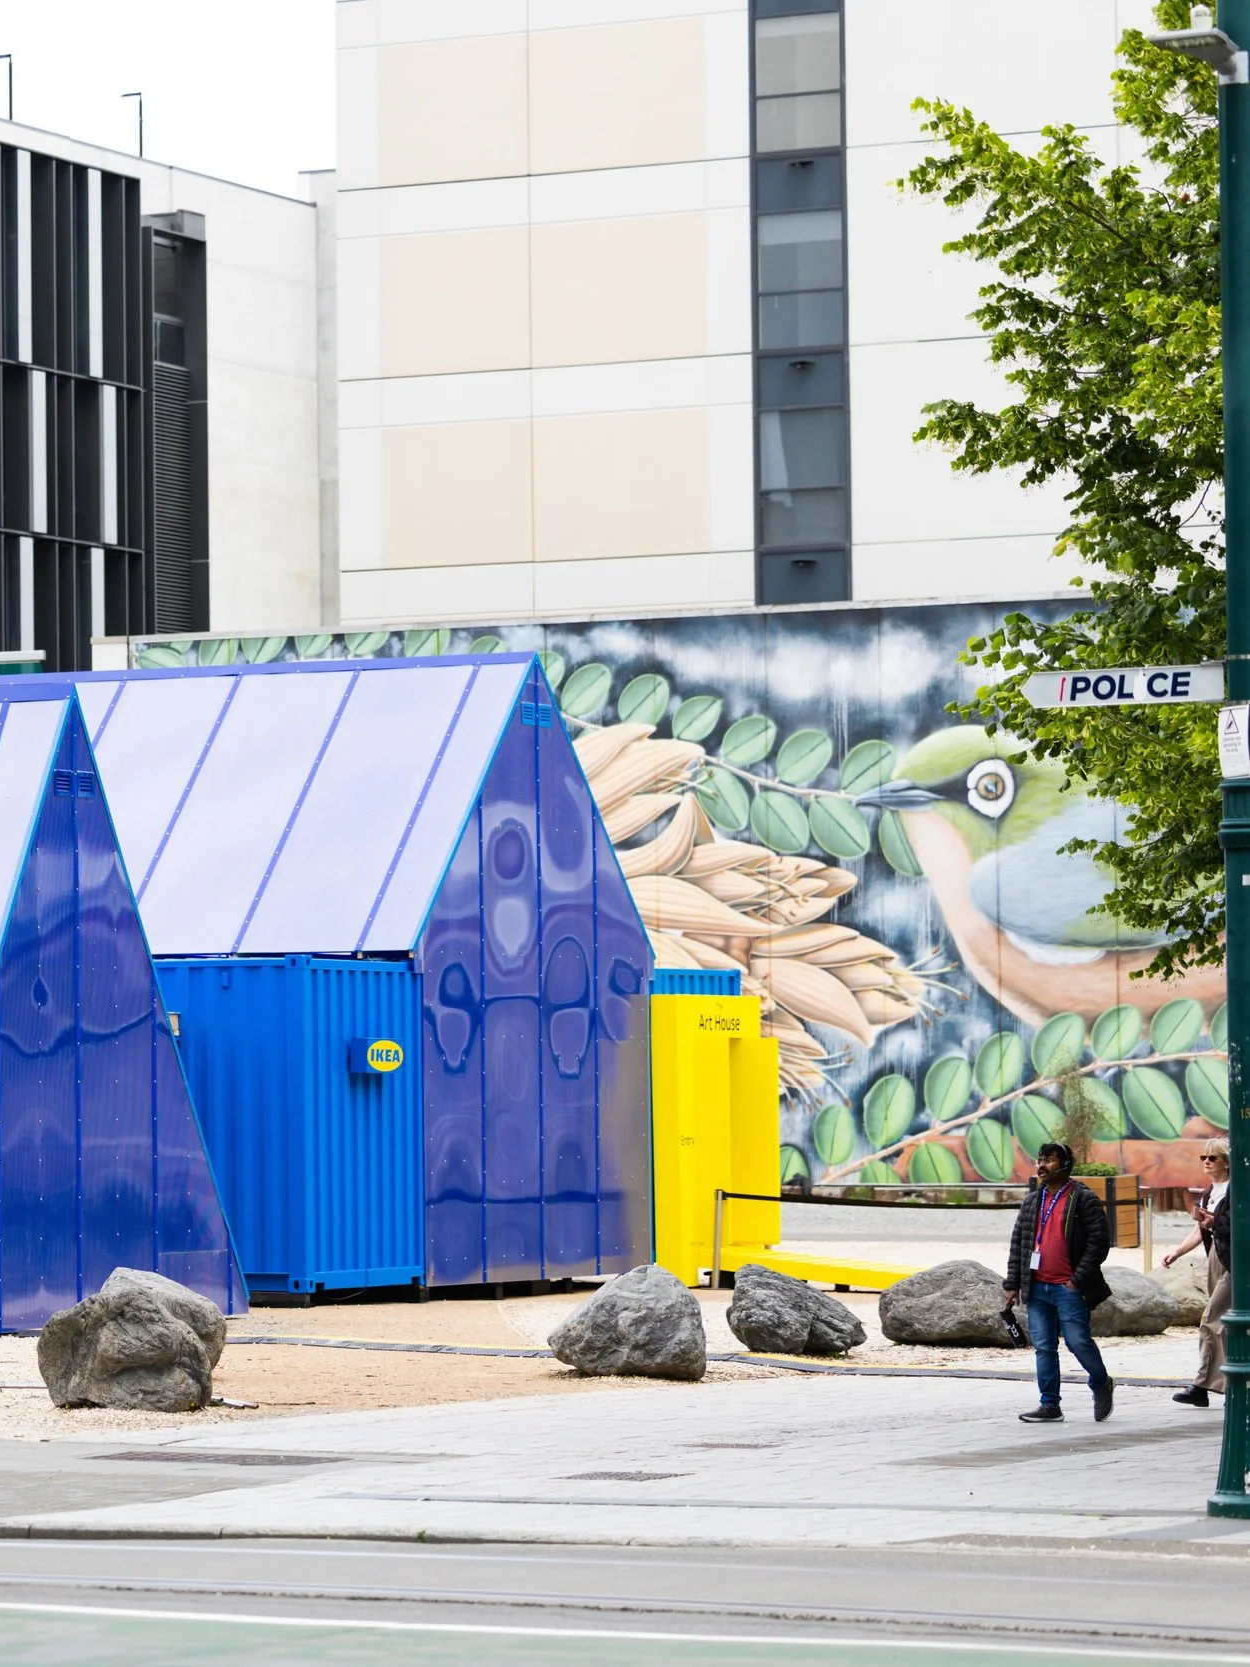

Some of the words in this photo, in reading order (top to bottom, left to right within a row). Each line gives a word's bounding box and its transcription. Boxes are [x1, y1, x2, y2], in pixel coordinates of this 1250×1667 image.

[1070, 671, 1191, 701] POLCE
[699, 1013, 713, 1031] Art
[715, 1013, 740, 1031] House
[370, 1048, 401, 1063] IKEA
